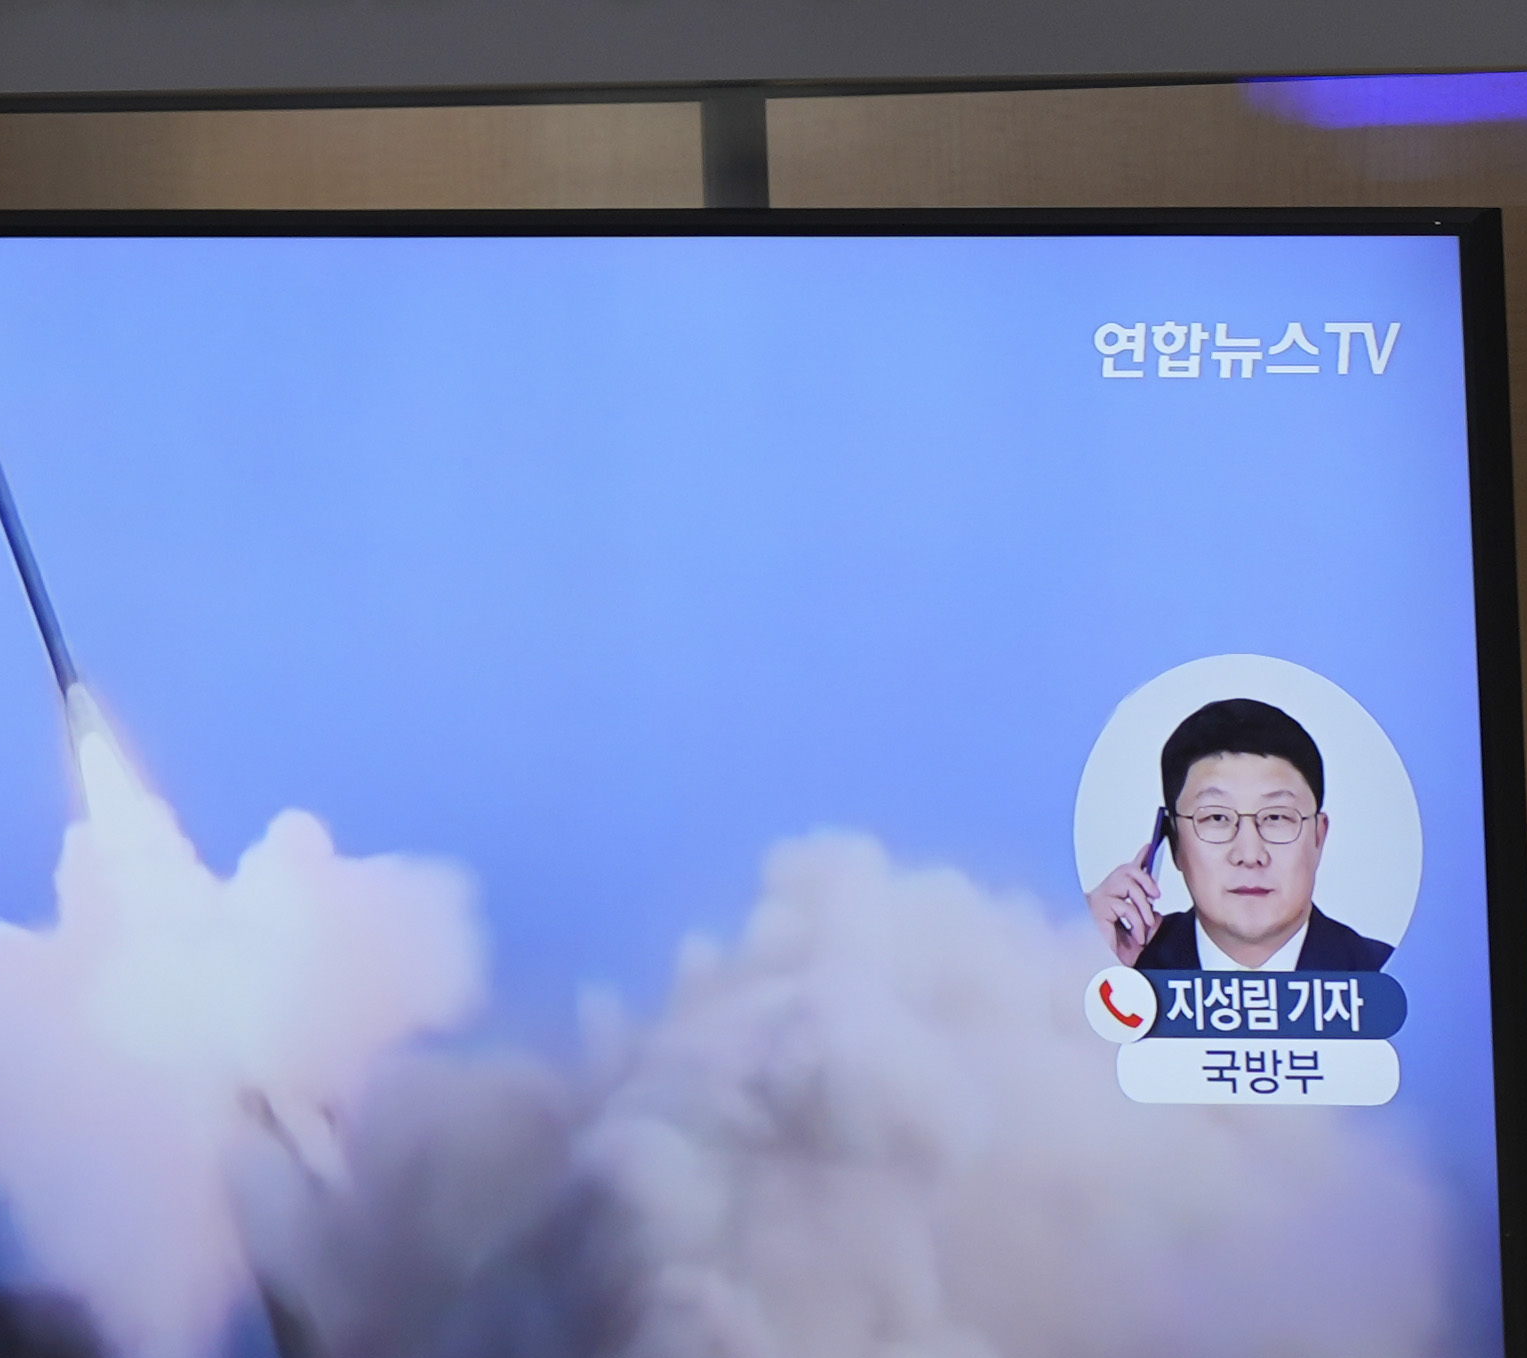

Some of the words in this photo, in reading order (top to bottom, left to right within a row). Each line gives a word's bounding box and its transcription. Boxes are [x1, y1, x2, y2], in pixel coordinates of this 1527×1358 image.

[1094, 321, 1401, 379] 연합뉴스TV
[1166, 976, 1278, 1032] 지성림
[1287, 978, 1365, 1032] 기자
[1201, 1049, 1325, 1095] 국방부
